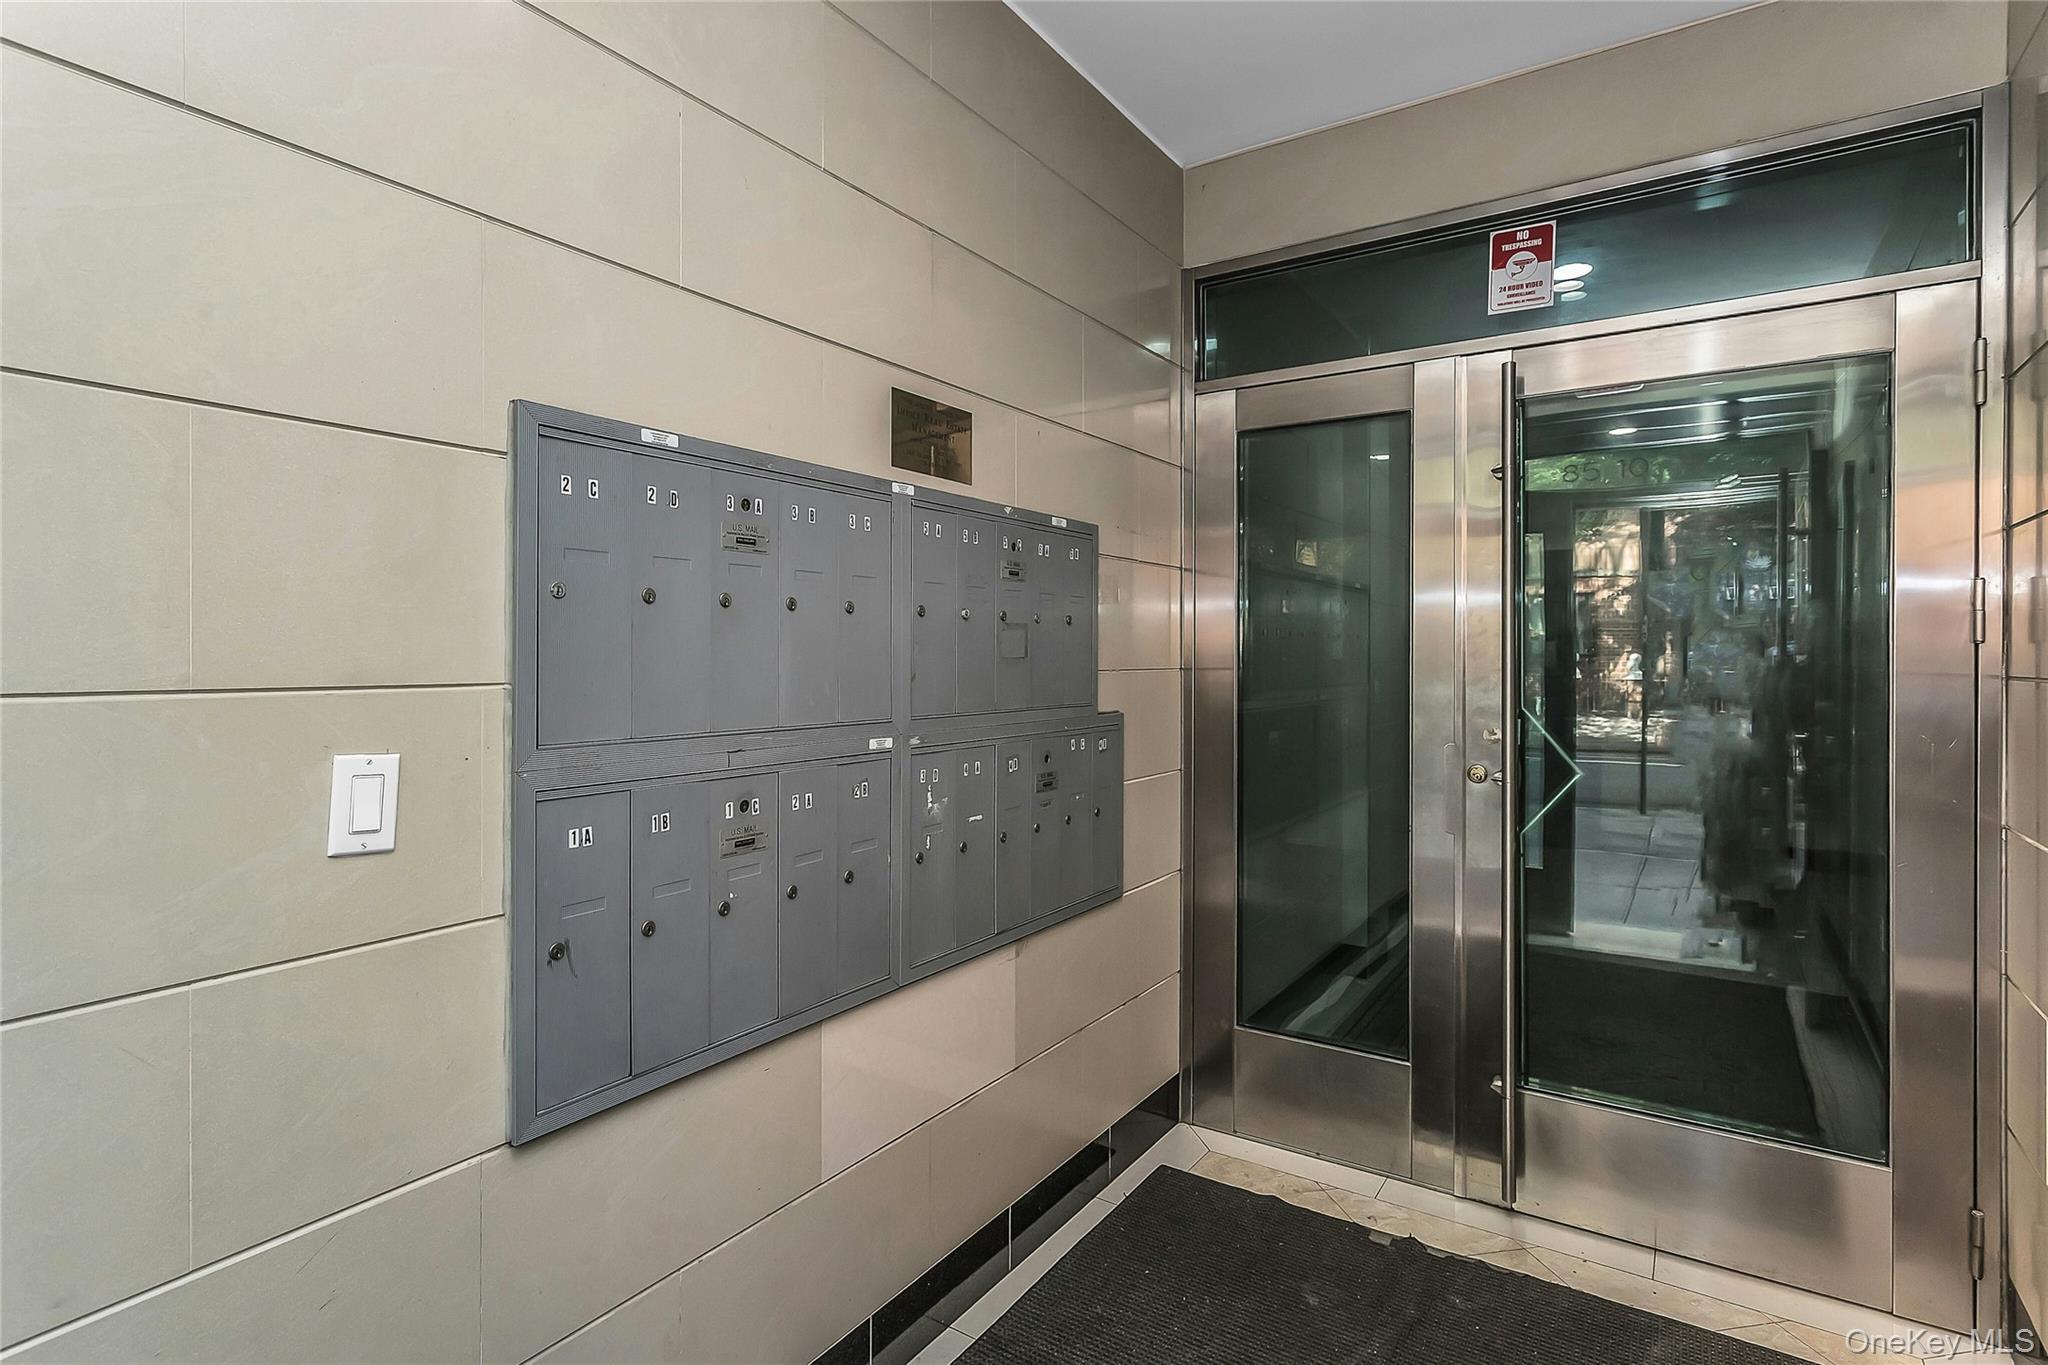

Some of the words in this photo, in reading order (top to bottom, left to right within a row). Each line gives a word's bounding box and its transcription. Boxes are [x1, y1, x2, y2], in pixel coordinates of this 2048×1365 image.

[1516, 229, 1529, 241] NO
[1501, 238, 1543, 252] TRESPASSING
[1507, 283, 1524, 292] HOUR
[1525, 280, 1544, 289] VIDEO
[1562, 461, 1600, 482] 85
[562, 476, 570, 493] 2
[589, 481, 598, 498] C
[648, 487, 656, 502] 2
[670, 491, 678, 507] D
[726, 495, 733, 510] 3
[755, 500, 762, 515] A
[791, 505, 798, 519] 3
[809, 508, 815, 522] B
[849, 514, 855, 528] 3
[727, 802, 732, 818] 1
[752, 799, 758, 814] C
[792, 795, 799, 809] 2
[806, 794, 812, 808] A
